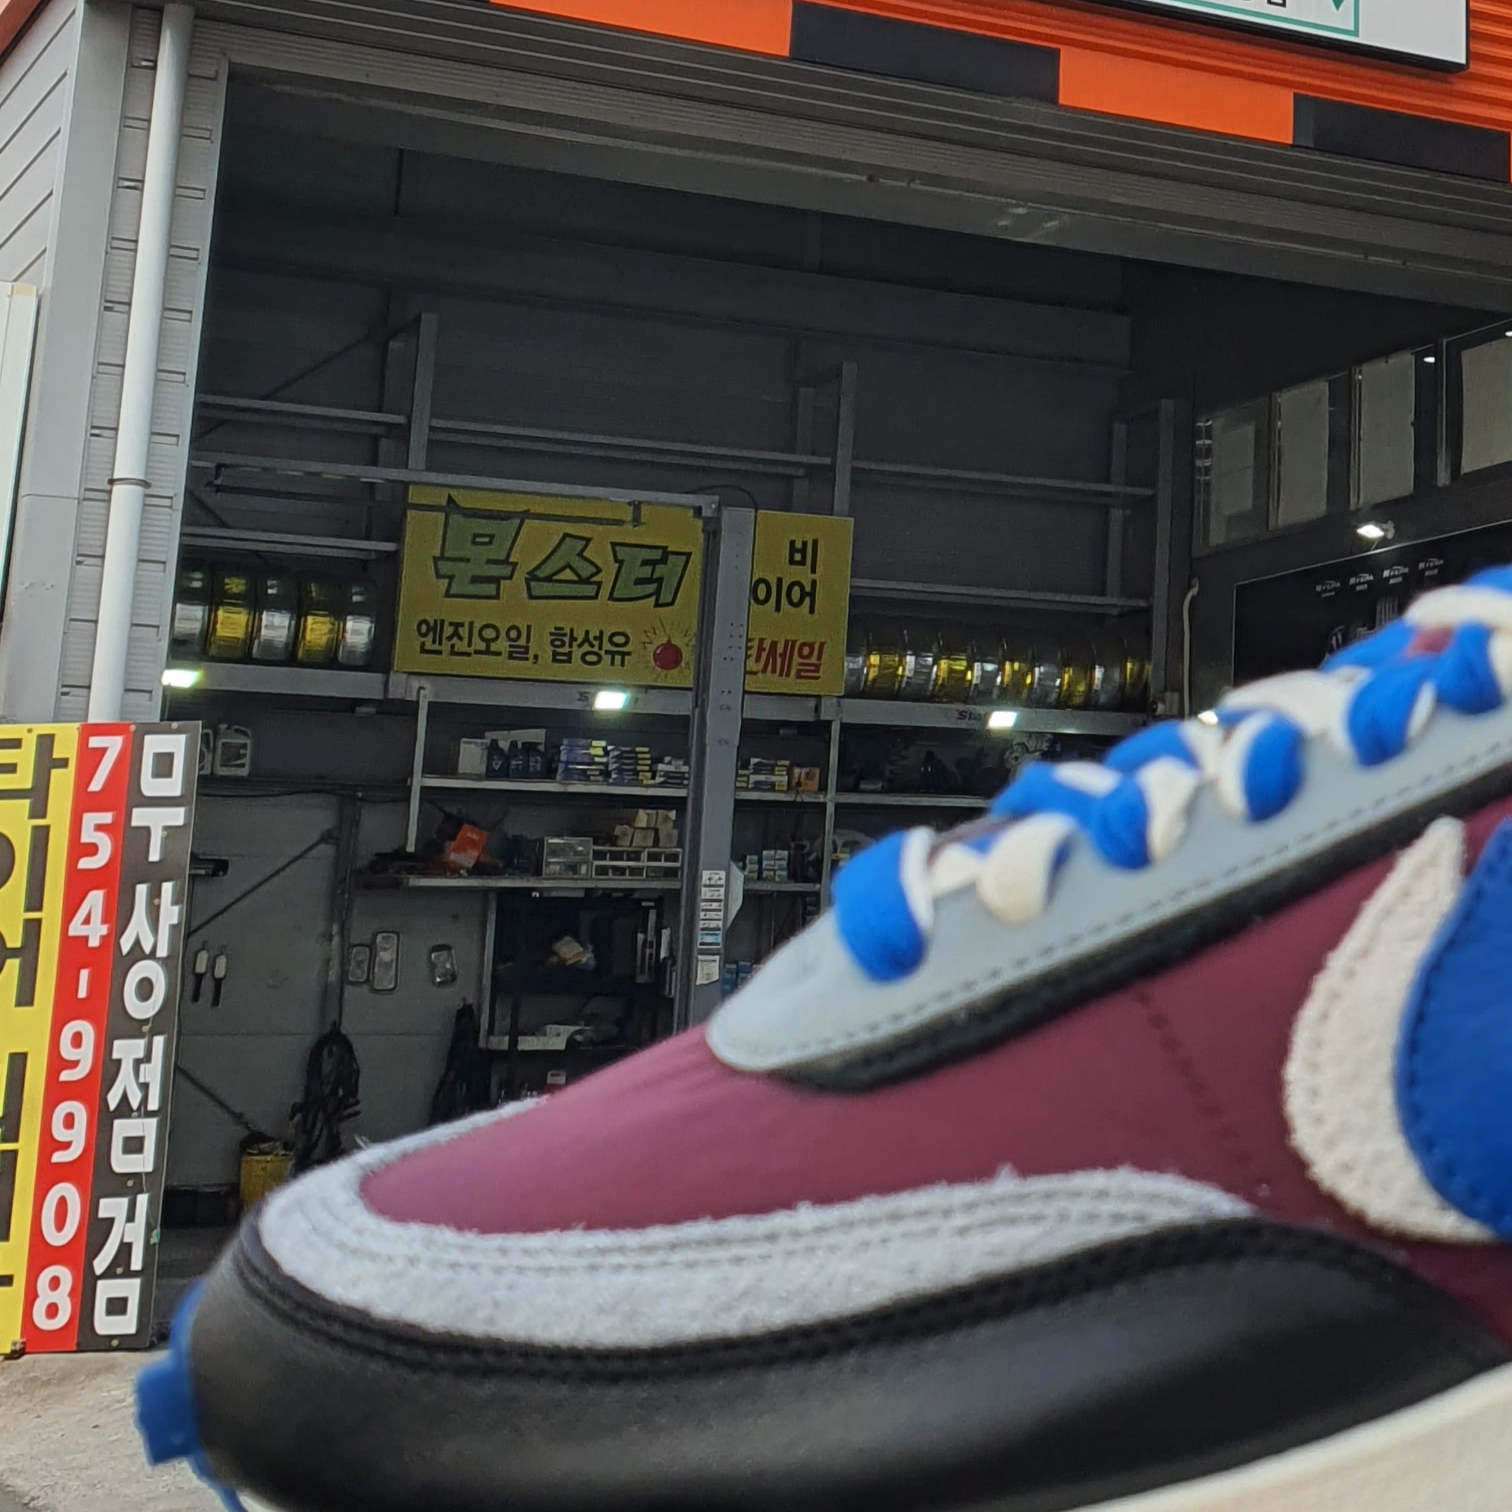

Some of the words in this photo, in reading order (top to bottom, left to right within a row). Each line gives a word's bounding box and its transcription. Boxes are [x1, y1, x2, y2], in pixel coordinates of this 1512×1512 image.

[433, 494, 690, 608] 몬스터
[548, 626, 634, 668] 합성유
[91, 732, 188, 1337] 무상점검
